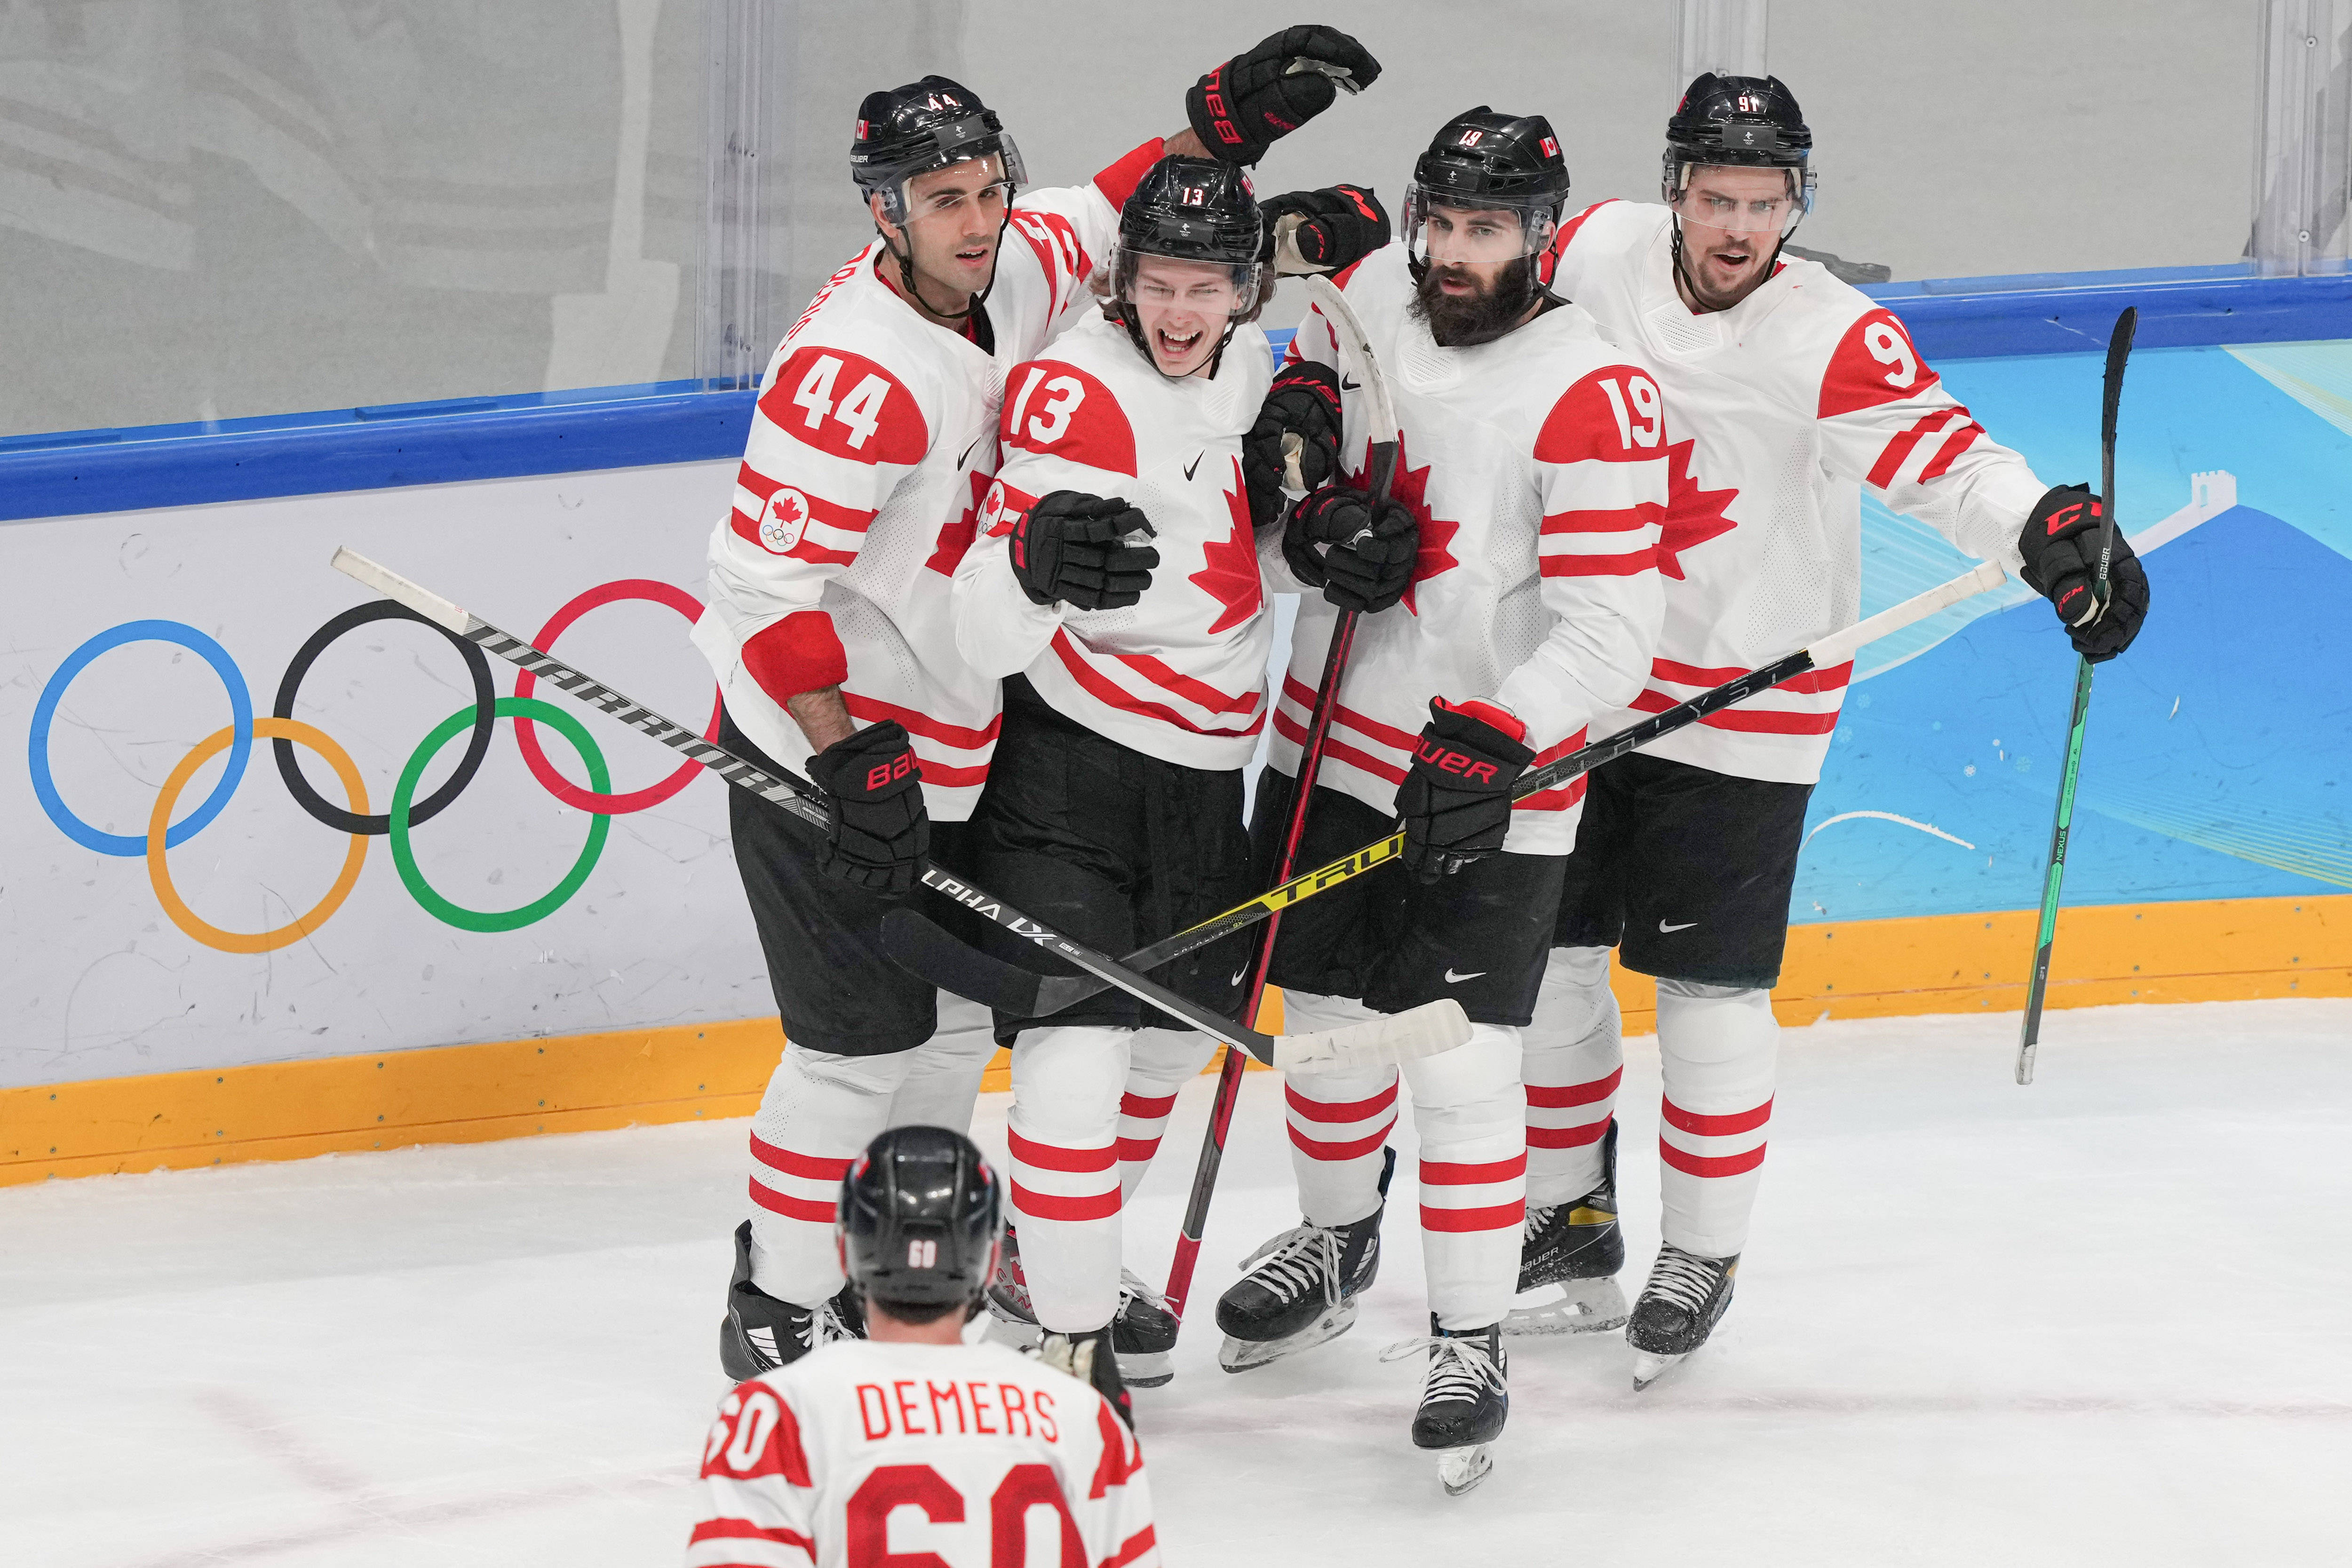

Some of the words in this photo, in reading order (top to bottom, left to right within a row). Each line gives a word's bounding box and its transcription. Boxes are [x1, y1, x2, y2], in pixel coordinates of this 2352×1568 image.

[928, 94, 959, 110] 44
[1205, 61, 1244, 144] BAU
[1738, 96, 1758, 112] 91
[1458, 129, 1484, 147] 19
[1182, 187, 1204, 206] 13
[793, 354, 891, 450] 44
[1010, 367, 1086, 444] 13
[1597, 376, 1661, 449] 19
[2099, 547, 2111, 580] BAUER
[462, 624, 780, 796] WARRIOR
[1536, 663, 1783, 791] ATALYST
[1271, 838, 1398, 903] TRU
[2055, 830, 2066, 860] NEXUS
[921, 870, 1001, 921] LPHA
[908, 1240, 937, 1268] 60
[856, 1381, 1058, 1442] DEMERS
[847, 1464, 1088, 1568] 60
